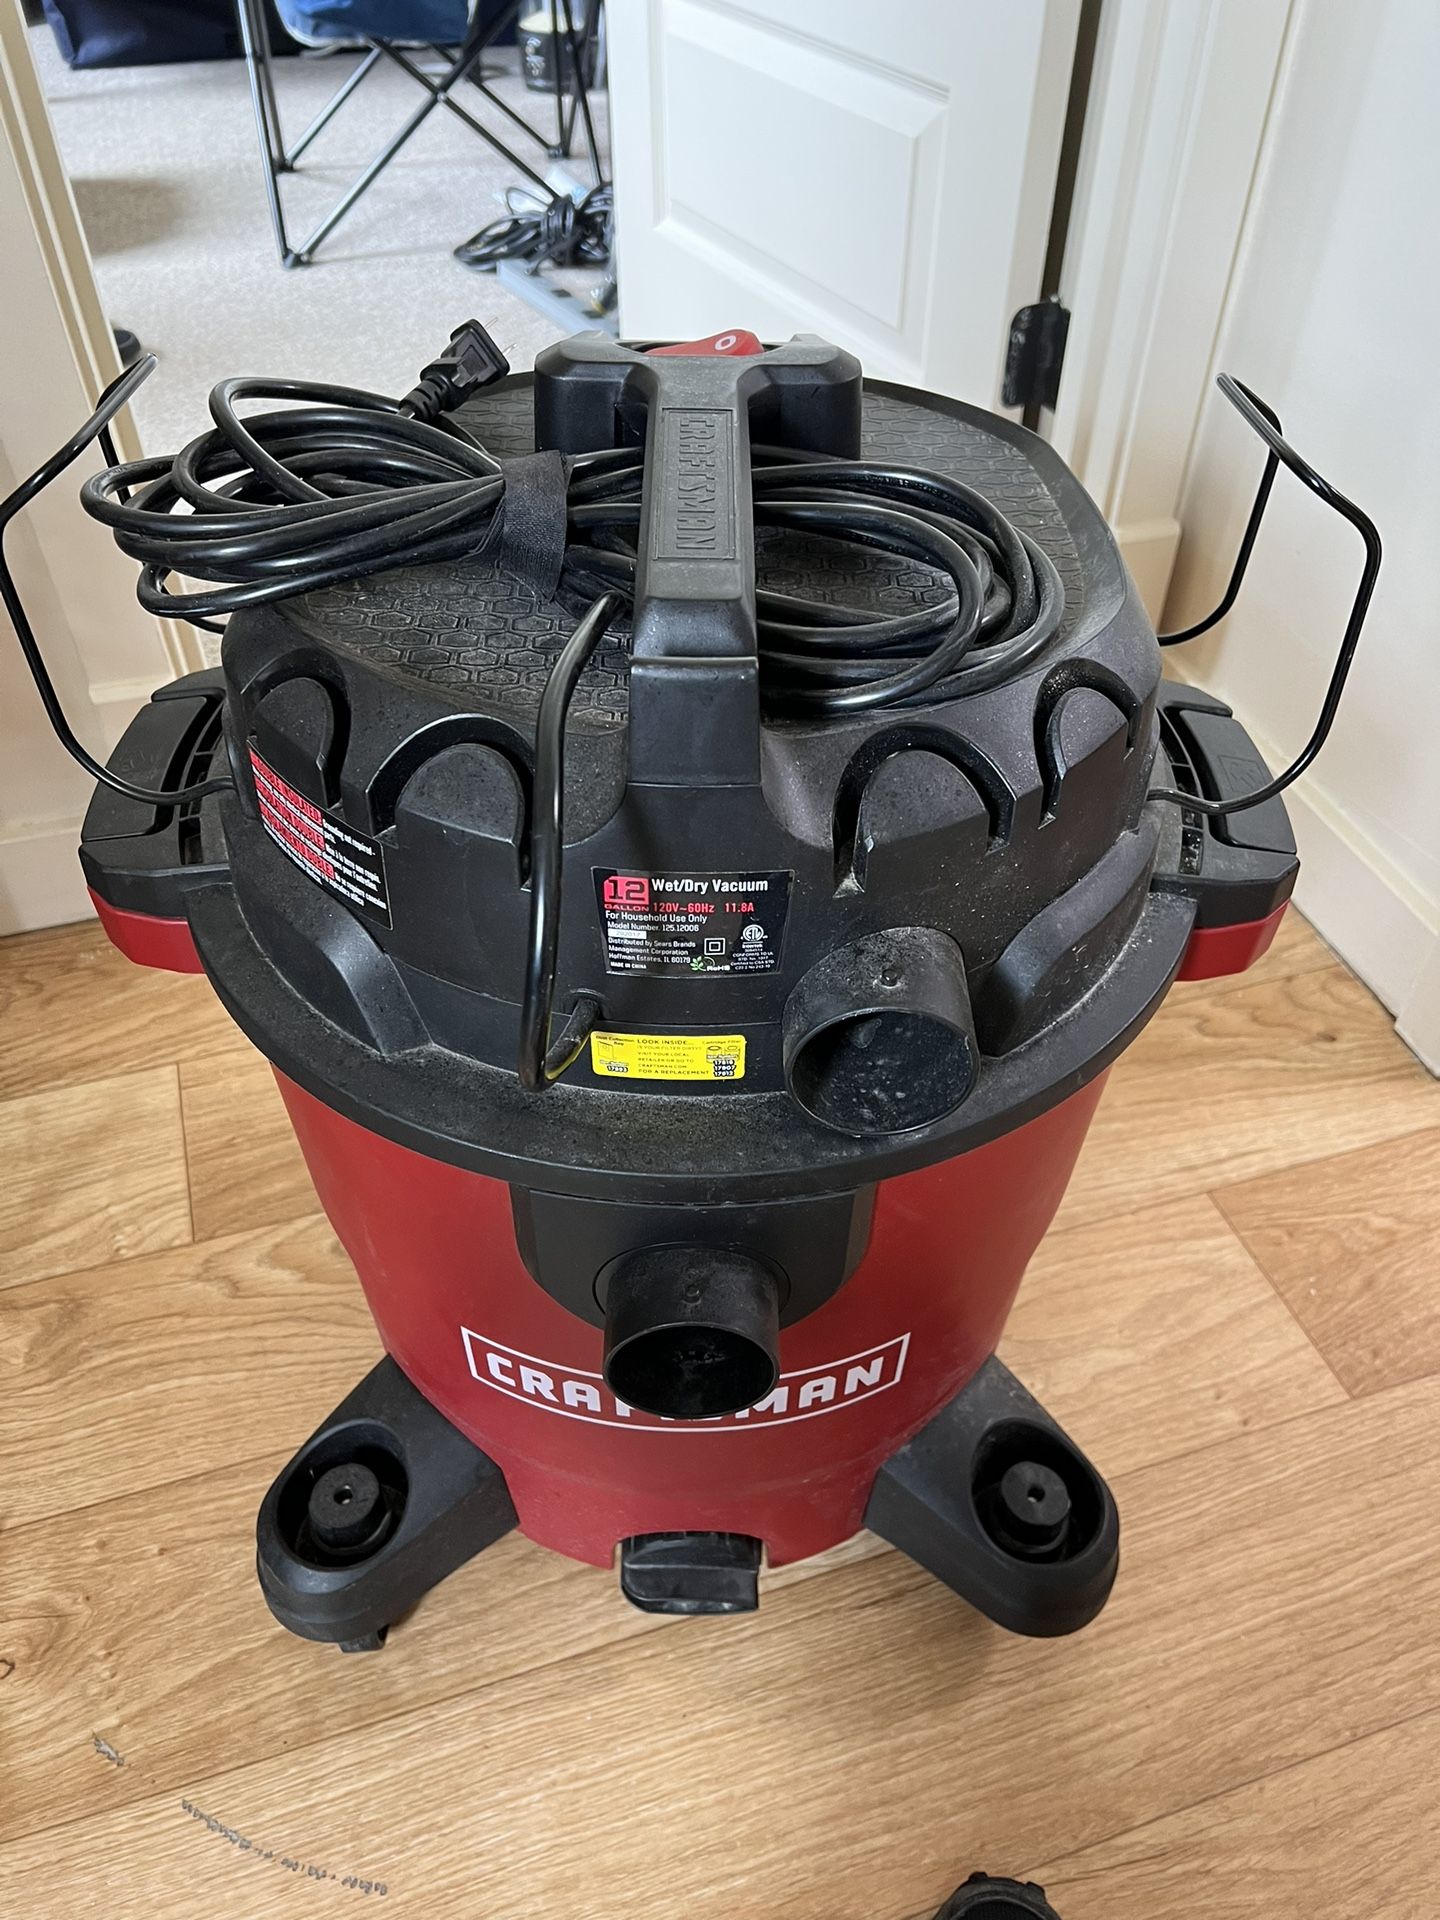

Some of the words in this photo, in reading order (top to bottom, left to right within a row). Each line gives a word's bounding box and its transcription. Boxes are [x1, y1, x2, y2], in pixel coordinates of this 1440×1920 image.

[676, 418, 715, 550] CRAFTSMAN
[608, 879, 645, 901] 12
[652, 878, 709, 894] Wet/Dry
[712, 879, 769, 892] Vacuum
[604, 903, 649, 912] GALLON
[654, 902, 715, 913] 120V~60Hz
[605, 910, 619, 919] For
[621, 911, 668, 922] Household
[669, 914, 686, 922] Use
[688, 914, 707, 924] Only
[607, 921, 629, 929] Model
[608, 937, 643, 946] Distributed
[645, 939, 652, 947] by
[608, 945, 649, 954] Management
[650, 948, 688, 956] Corporation
[608, 953, 635, 961] Hoffman
[486, 1353, 885, 1422] CRAMAN
